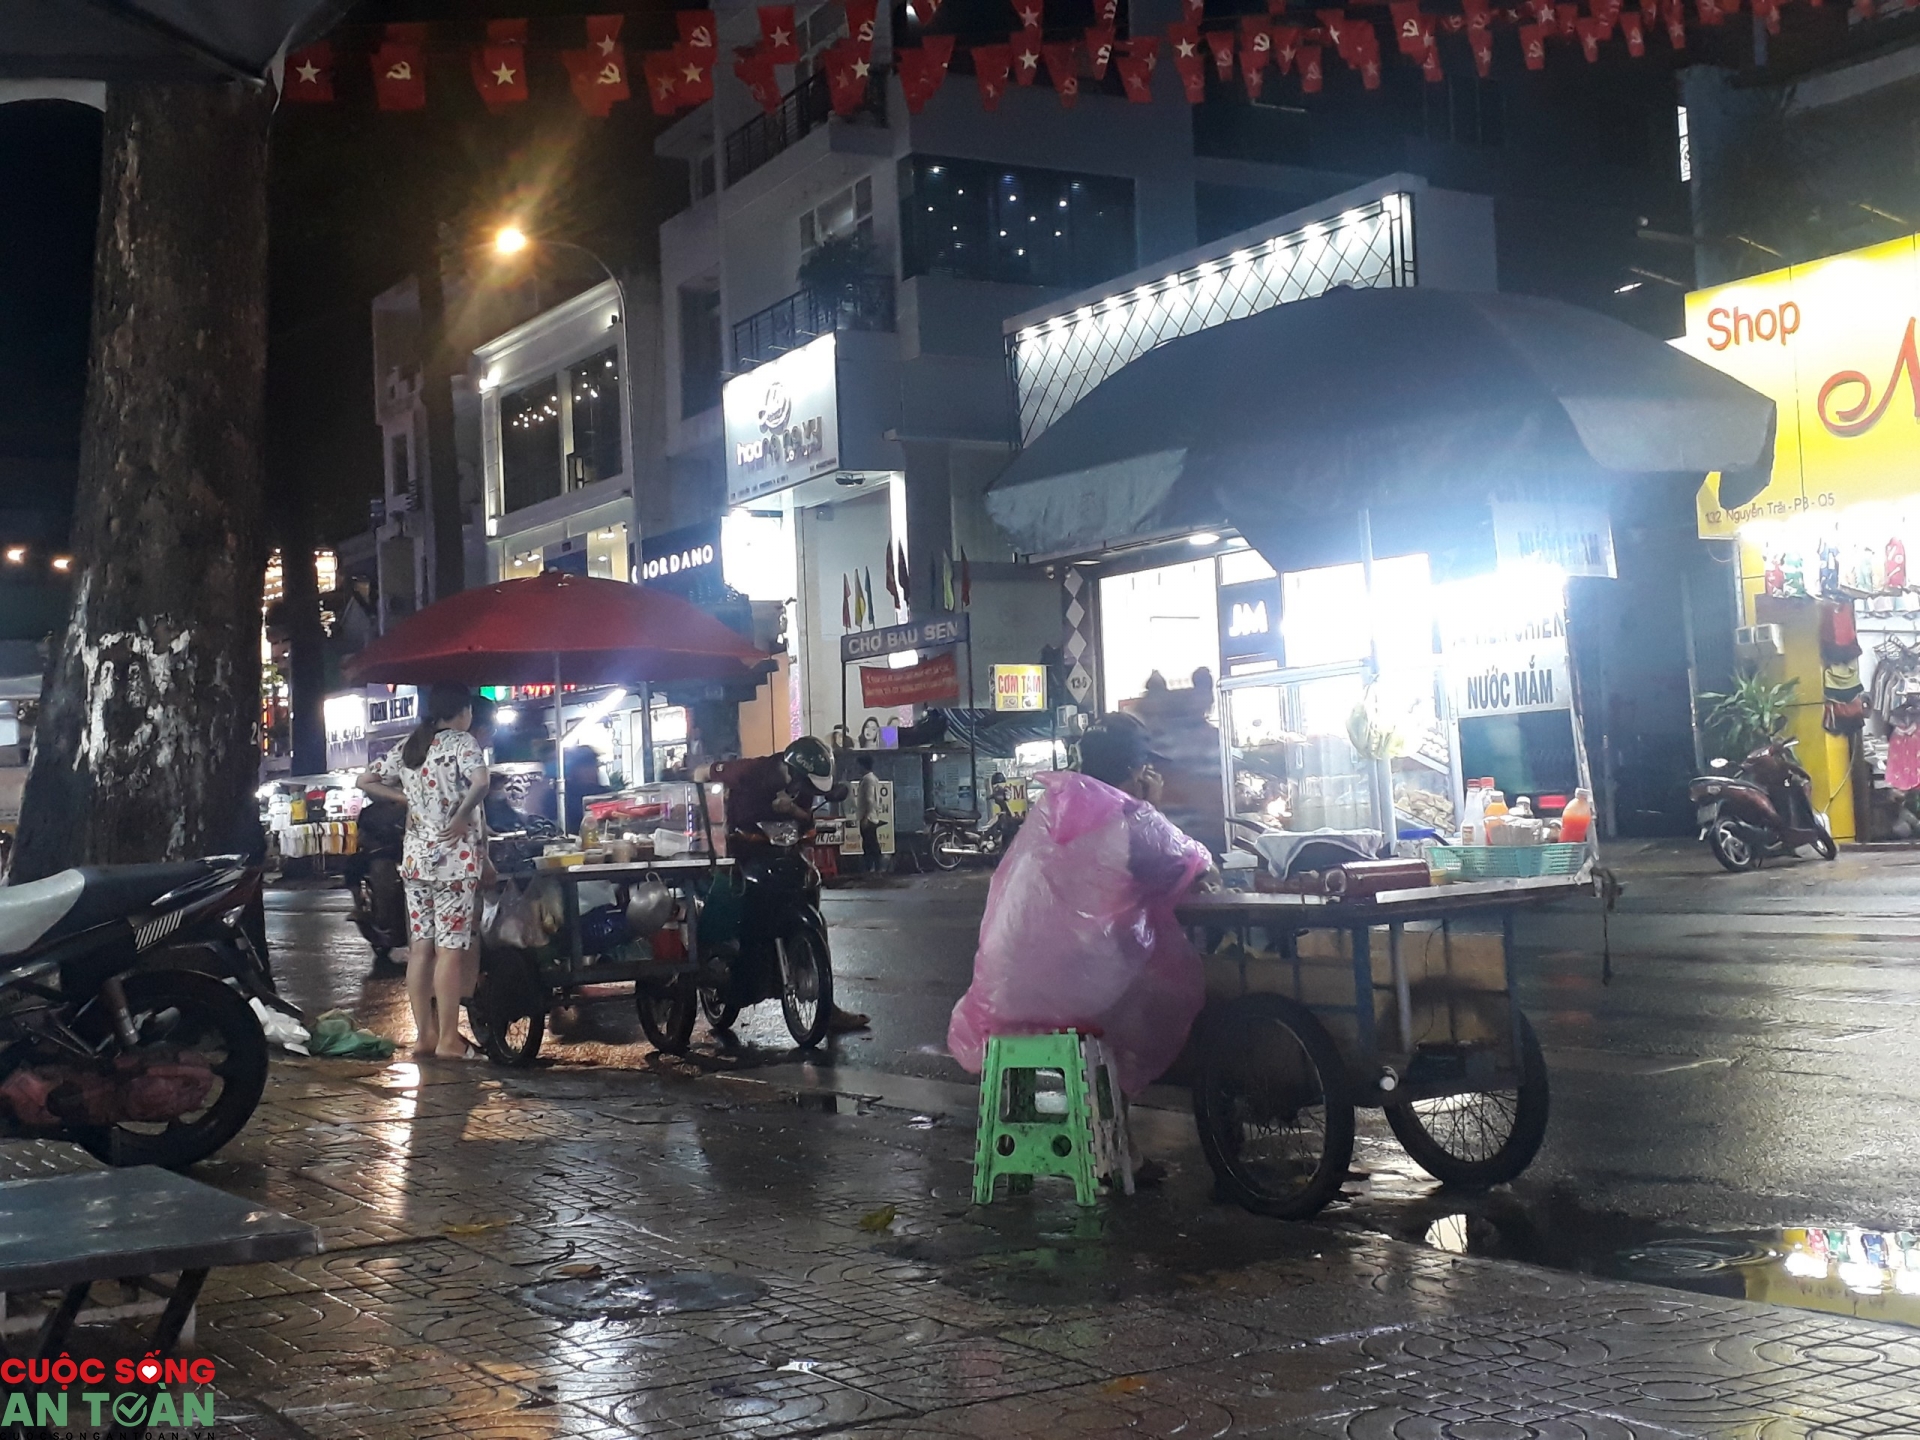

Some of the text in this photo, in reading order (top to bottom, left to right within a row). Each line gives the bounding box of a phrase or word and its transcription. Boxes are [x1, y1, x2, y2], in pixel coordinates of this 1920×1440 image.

[1707, 301, 1800, 351] Shop
[848, 631, 882, 655] CHỢ
[923, 620, 958, 641] SEN
[997, 673, 1019, 694] CƠM
[1467, 654, 1554, 709] NƯỚC MẮM
